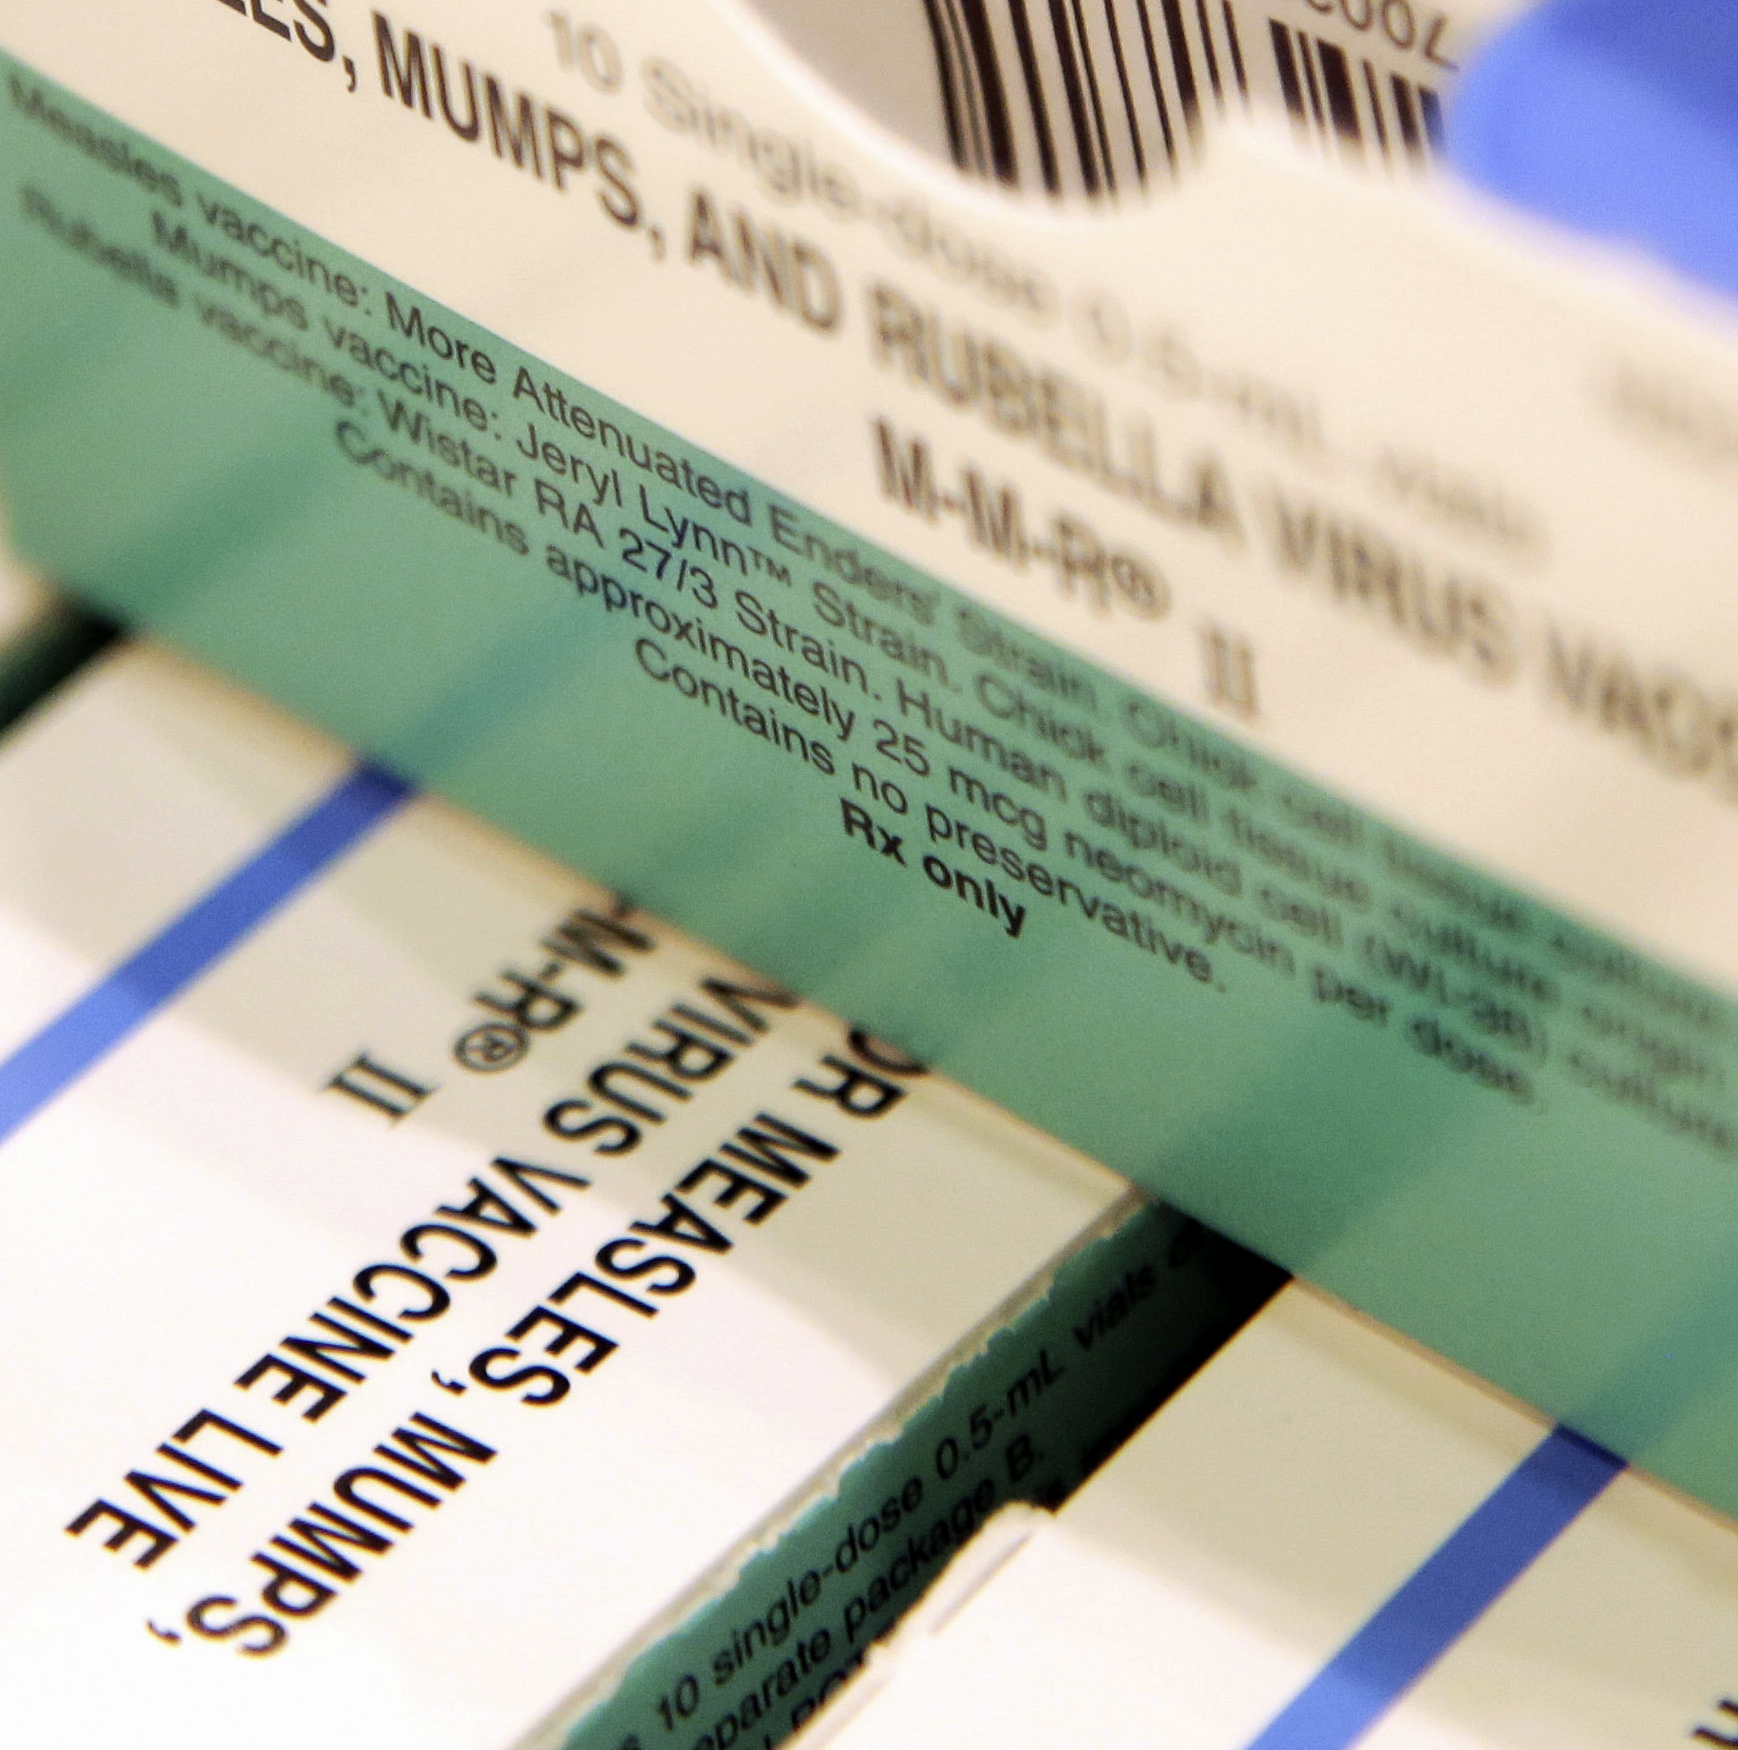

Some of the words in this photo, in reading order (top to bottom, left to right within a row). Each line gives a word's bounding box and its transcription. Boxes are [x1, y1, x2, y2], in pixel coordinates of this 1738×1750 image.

[10, 74, 179, 208] Measles
[203, 191, 368, 315] vaccine:
[387, 294, 493, 384] More
[510, 362, 751, 529] Attenuated
[369, 12, 671, 262] MUMPS,
[681, 182, 847, 340] AND
[866, 290, 1248, 555] RUBELLA
[1266, 479, 1507, 690] VIRUS
[28, 190, 179, 310] Rubella
[197, 292, 365, 415] vaccine:
[382, 393, 517, 501] Wistar
[536, 481, 597, 546] RA
[620, 525, 714, 611] 27/3
[735, 589, 877, 701] Strain.
[895, 678, 1064, 803] Human
[1086, 782, 1241, 903] diploid
[1262, 877, 1341, 952] cell
[153, 212, 308, 336] Mumps
[326, 313, 500, 441] vaccine:
[517, 419, 621, 514] Jeryl
[639, 485, 792, 608] Lynn™
[813, 582, 959, 696] Strain.
[980, 673, 1105, 771] Chick
[1130, 756, 1204, 825] cell
[335, 417, 526, 559] Contains
[546, 537, 857, 746] approximately
[873, 716, 928, 778] 25
[950, 766, 1044, 850] mcg
[1066, 827, 1292, 982] neomycin
[1310, 955, 1391, 1041] per
[636, 636, 833, 777] Contains
[853, 762, 905, 817] no
[925, 796, 1220, 991] preservative.
[841, 797, 902, 862] Rx
[923, 844, 1026, 939] only
[317, 1052, 442, 1130] II
[543, 977, 799, 1158] VIRUS
[233, 1153, 592, 1425] VACCINE
[427, 1110, 843, 1410] MEASLES,
[62, 1408, 285, 1570] LIVE
[144, 1411, 500, 1659] MUMPS,
[653, 1675, 703, 1736] 10
[711, 1502, 931, 1686] single-dose
[931, 1356, 1065, 1478] 0.5-mL
[1073, 1272, 1163, 1350] vials
[841, 1483, 1003, 1638] package
[998, 1432, 1048, 1486] B.
